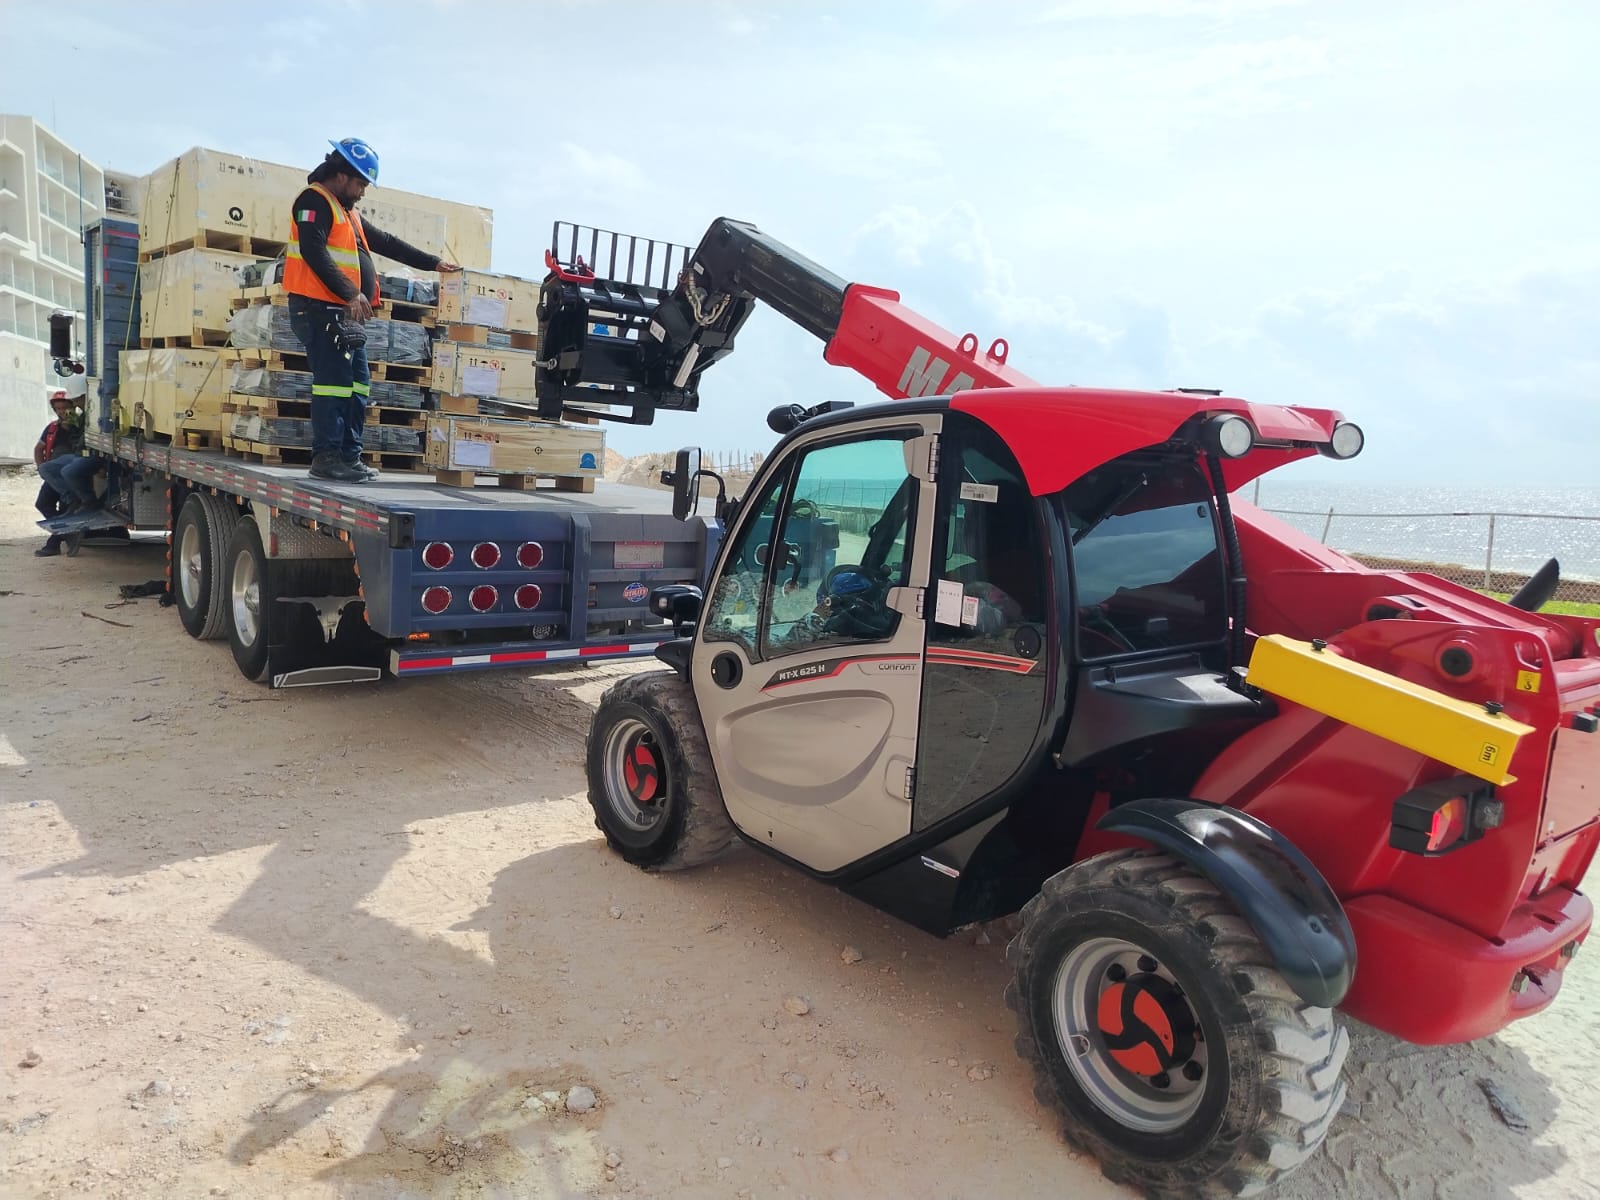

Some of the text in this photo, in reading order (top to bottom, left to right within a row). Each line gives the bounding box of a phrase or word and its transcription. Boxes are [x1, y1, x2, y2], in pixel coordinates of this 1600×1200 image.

[779, 664, 825, 681] MT-X 625 H
